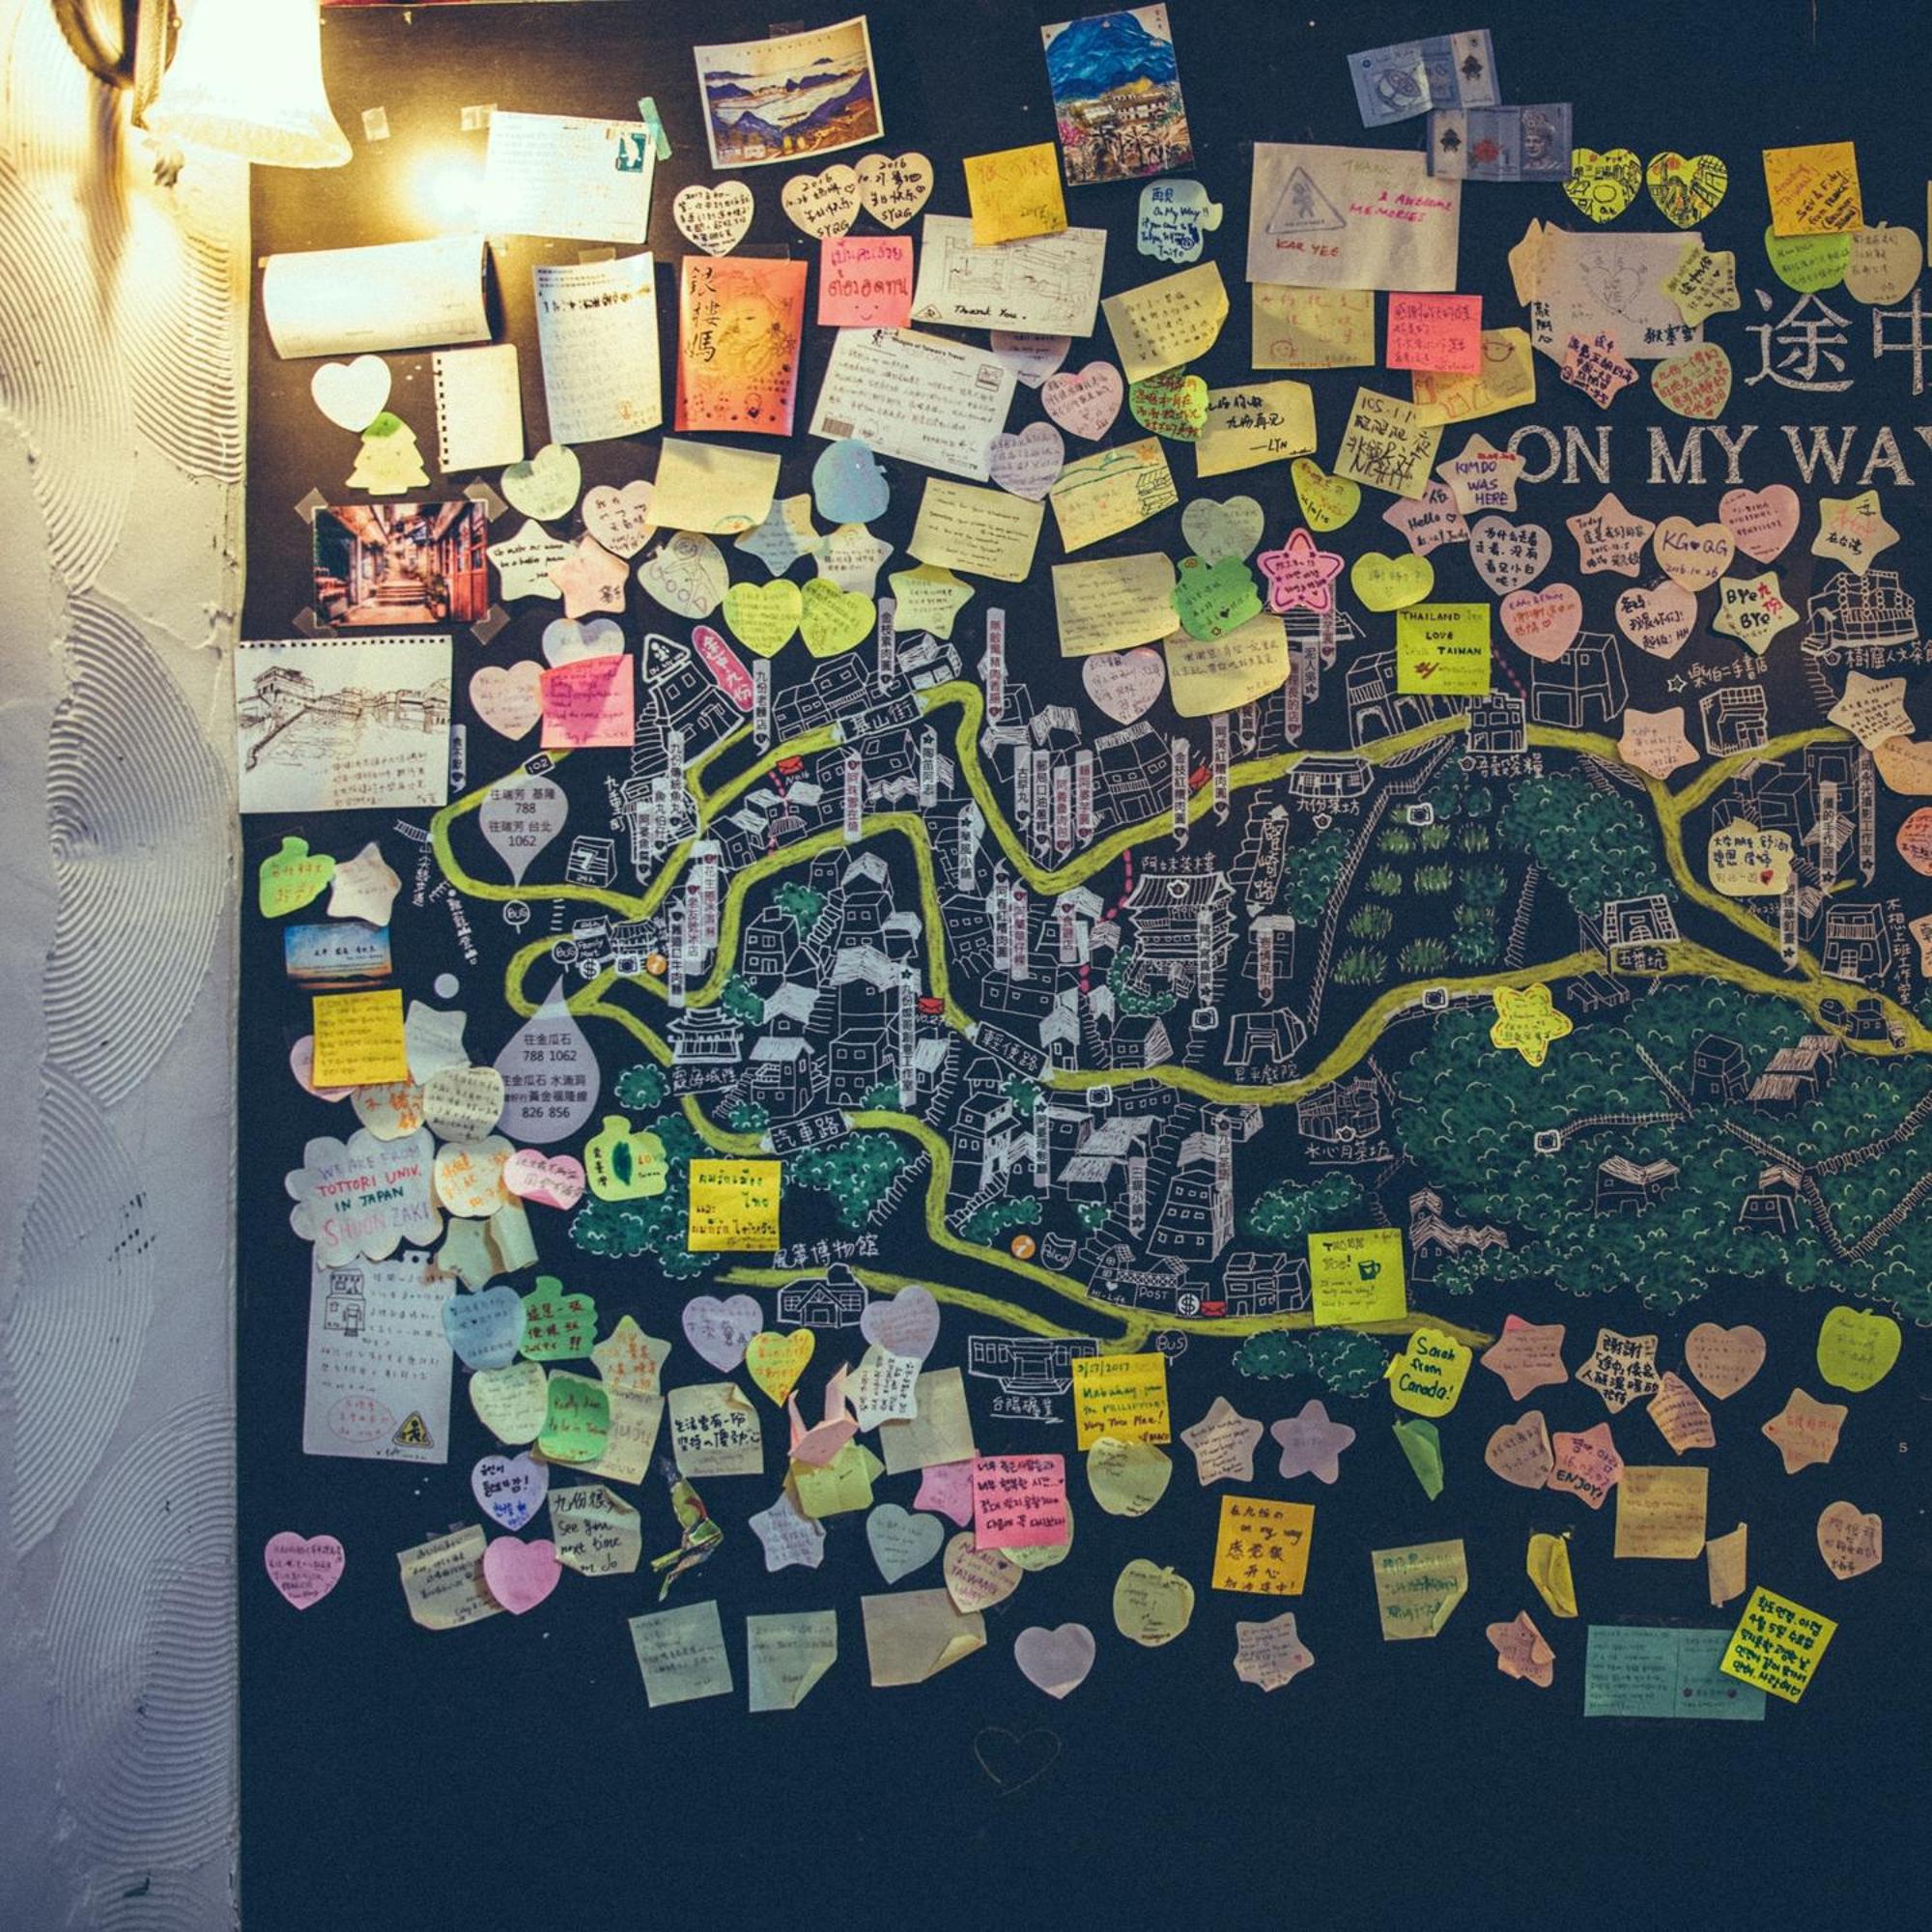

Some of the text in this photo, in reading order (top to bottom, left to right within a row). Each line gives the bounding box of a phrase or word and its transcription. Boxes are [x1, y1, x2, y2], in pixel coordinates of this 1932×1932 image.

[1507, 426, 1613, 484] ON
[1647, 426, 1759, 485] MY
[1467, 478, 1498, 491] WAS
[1475, 492, 1509, 506] HERE
[1407, 512, 1441, 531] Hello
[1401, 611, 1462, 622] THAILAND
[1436, 645, 1483, 656] TAIWAN
[849, 698, 915, 735] 基山街
[490, 788, 555, 801] 往瑞芳 基隆
[514, 802, 537, 813] 788
[489, 821, 553, 833] 往瑞芳 台北
[508, 835, 537, 847] 1062
[524, 1033, 572, 1045] 往金瓜石
[523, 1050, 578, 1062] 788 1062
[981, 1028, 1039, 1072] 輕便路
[522, 1106, 571, 1119] 826 856
[773, 1112, 839, 1148] 汽車路
[314, 1176, 377, 1197] TOTTORI
[334, 1185, 405, 1212] IN JAPAN
[1417, 1337, 1456, 1361] Sarah
[1410, 1357, 1442, 1376] from
[1400, 1374, 1455, 1400] Canada!
